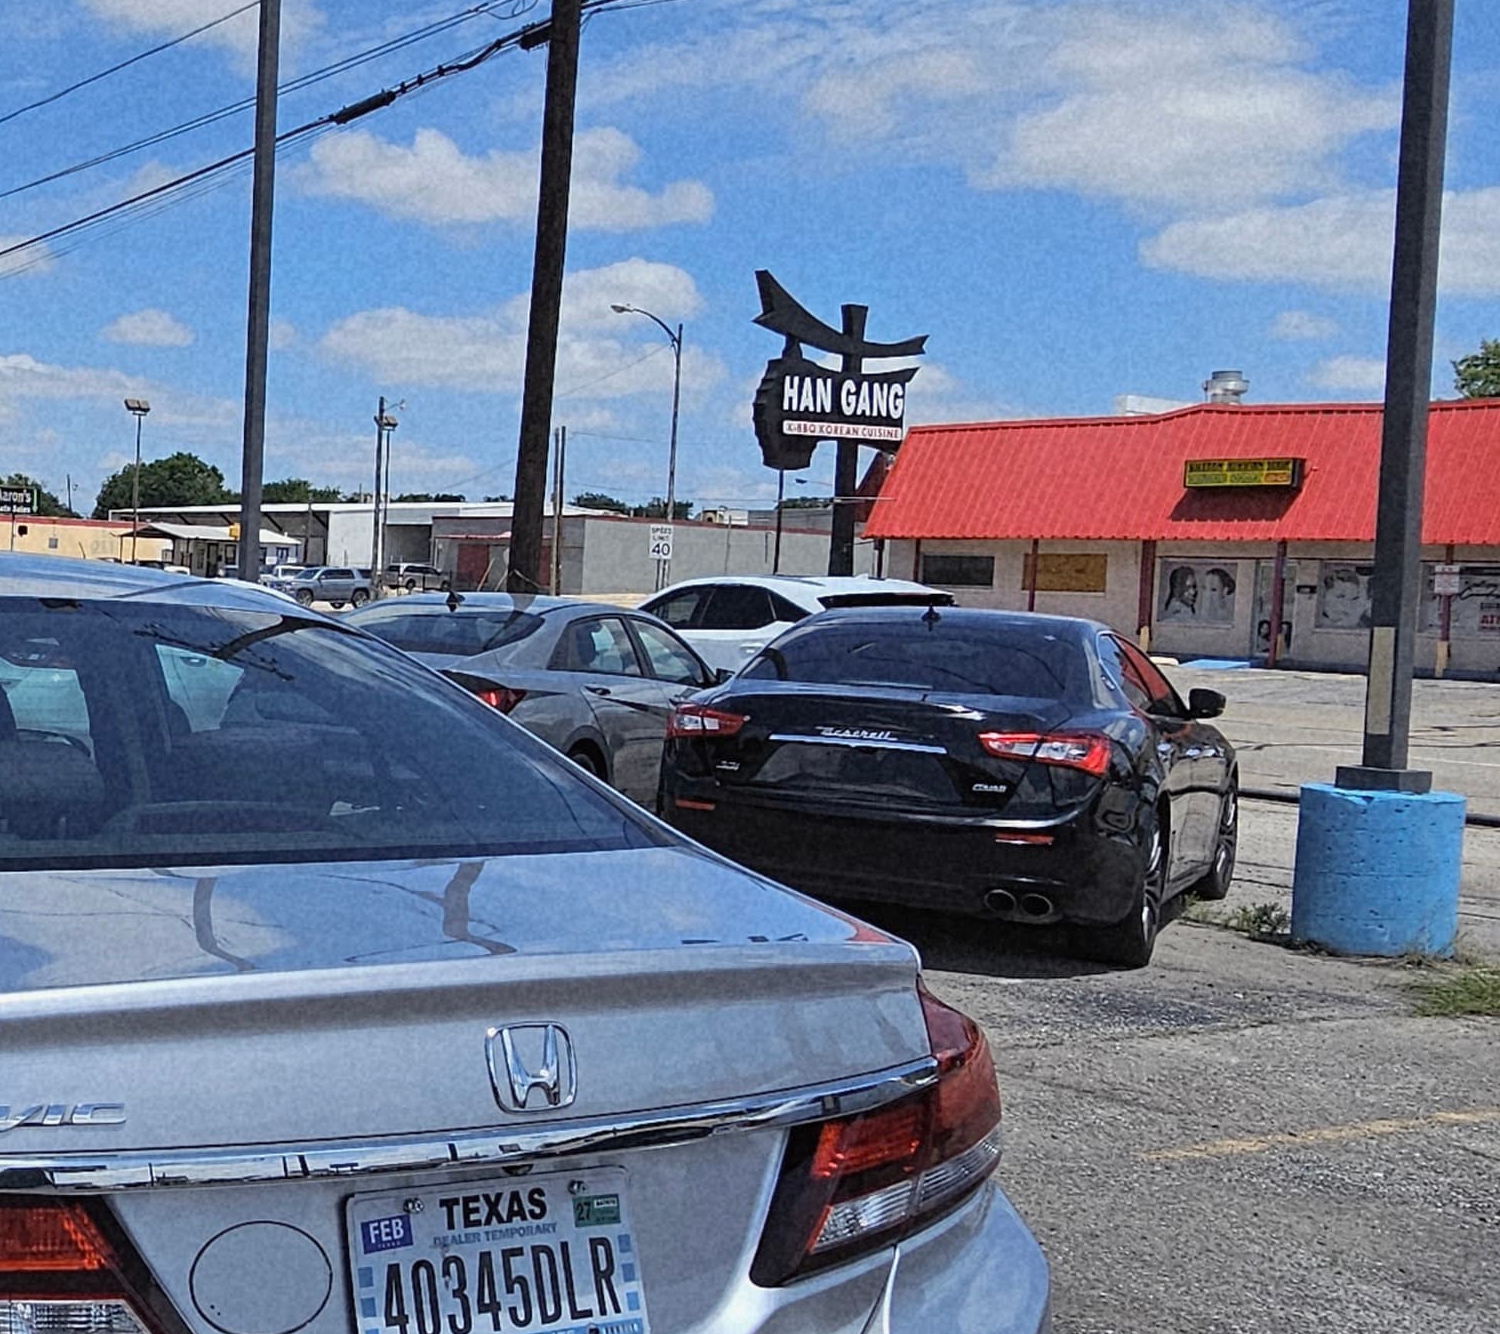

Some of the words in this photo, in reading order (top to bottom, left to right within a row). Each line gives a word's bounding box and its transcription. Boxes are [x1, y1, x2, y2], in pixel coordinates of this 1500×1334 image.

[782, 375, 833, 413] HAN
[840, 379, 904, 419] GANG
[820, 425, 859, 436] KOREAN
[861, 427, 899, 439] CUISINE
[651, 543, 671, 556] 40
[439, 1187, 549, 1230] TEXAS
[575, 1201, 591, 1222] 27
[369, 1218, 404, 1244] FEB
[433, 1230, 482, 1247] DEALER
[484, 1222, 558, 1243] TEMPORARY
